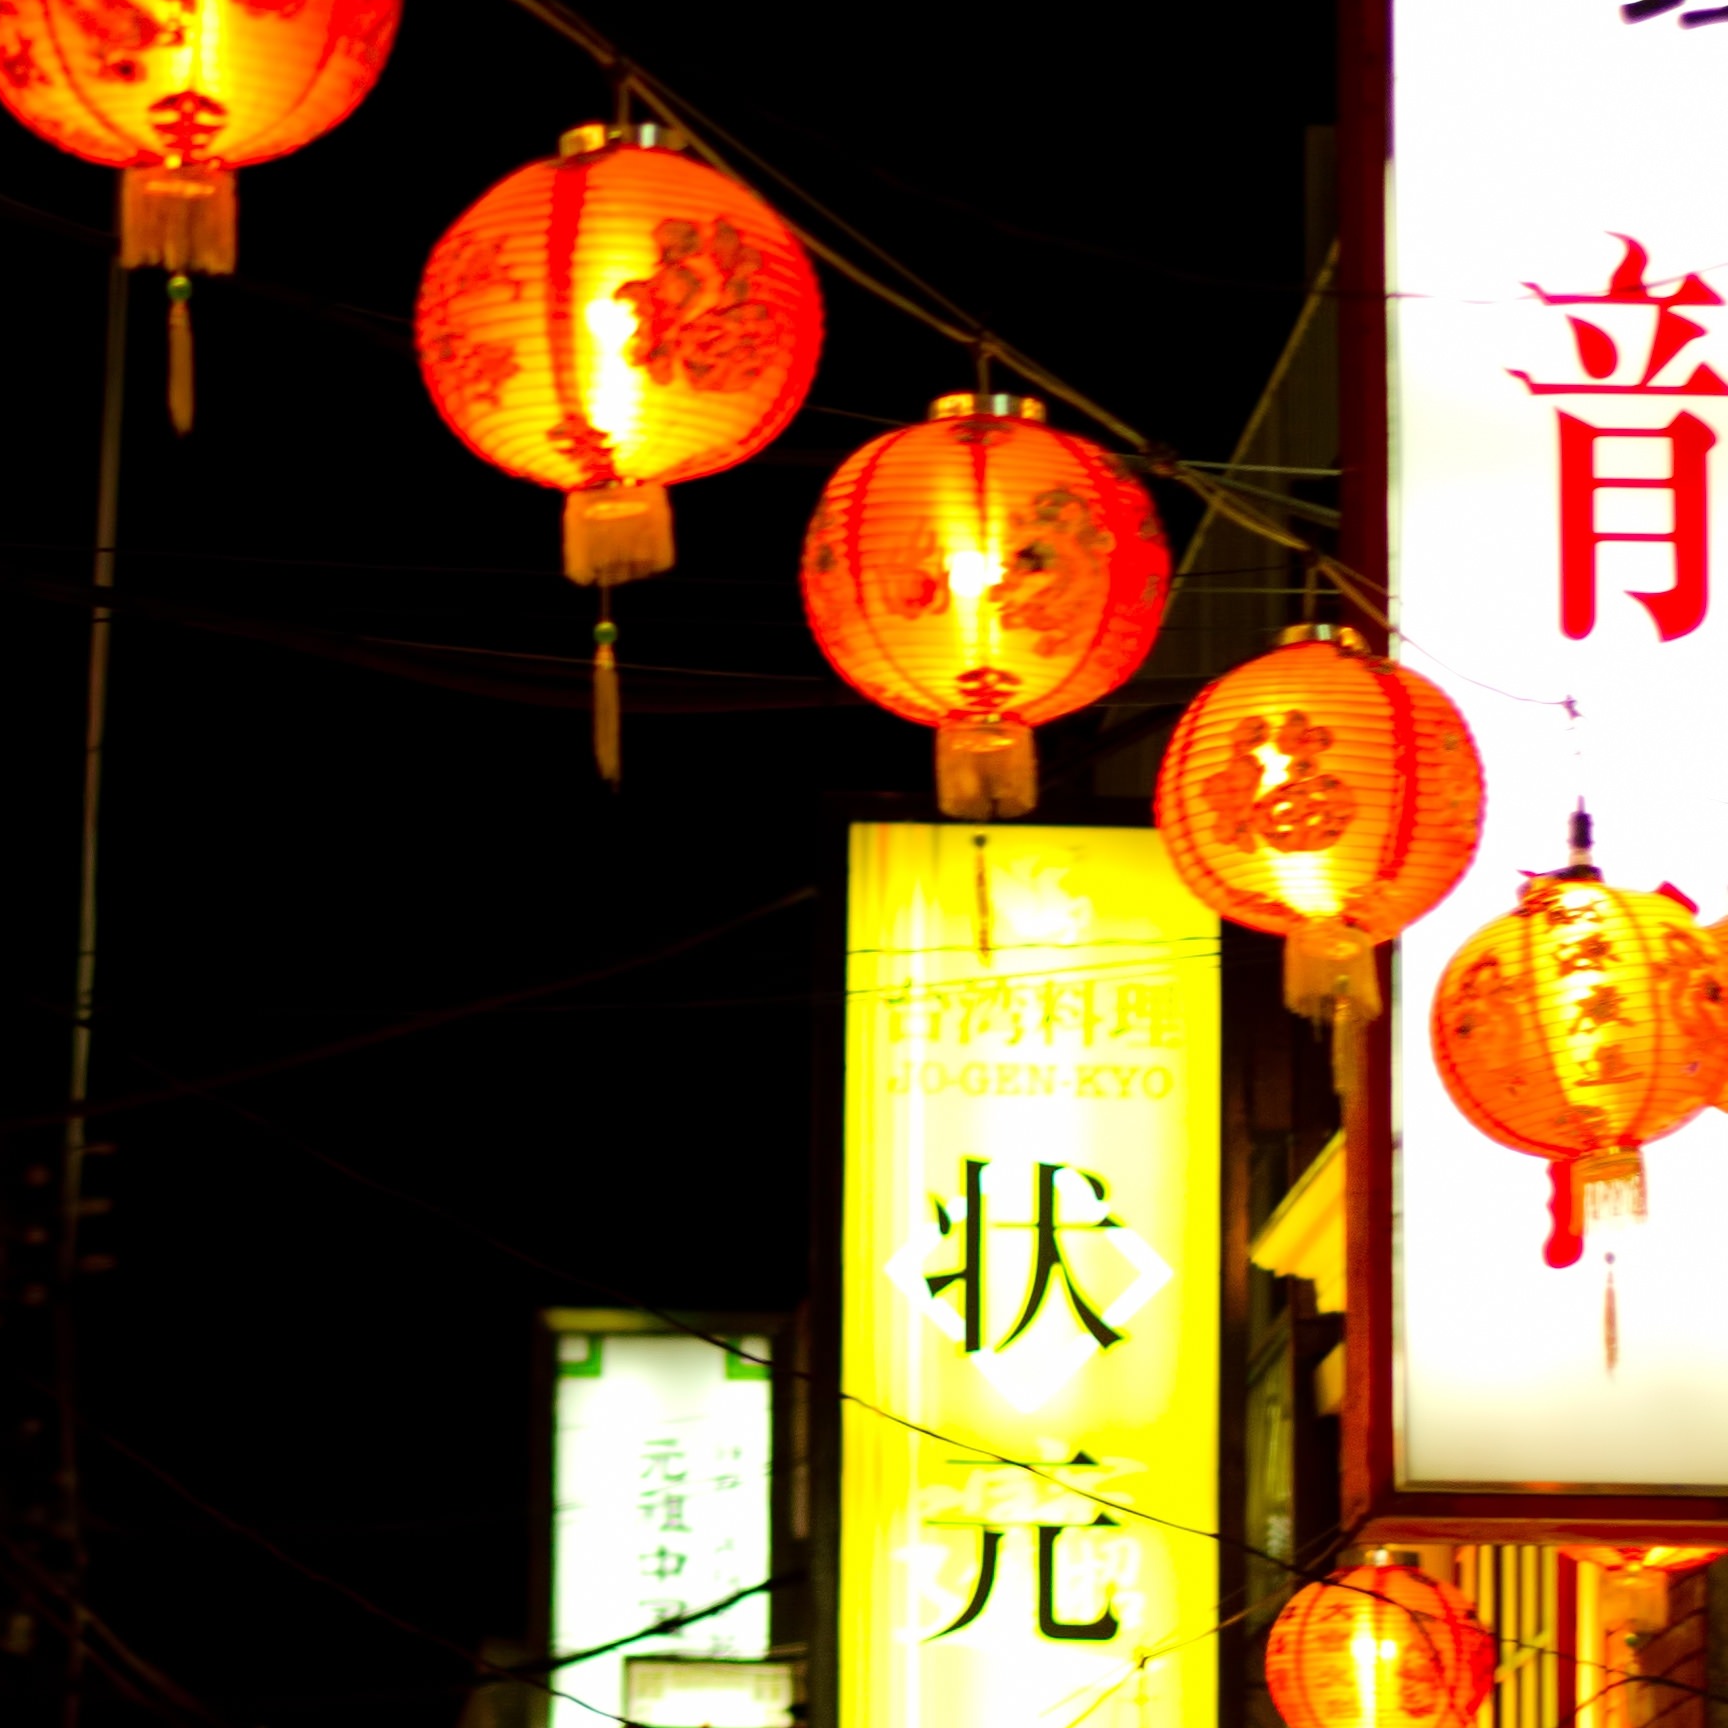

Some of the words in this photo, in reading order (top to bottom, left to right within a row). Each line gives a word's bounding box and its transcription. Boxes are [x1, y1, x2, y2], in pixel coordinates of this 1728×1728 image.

[881, 976, 1186, 1049] 台湾料理
[885, 1060, 1175, 1101] JO-GEN-KYO
